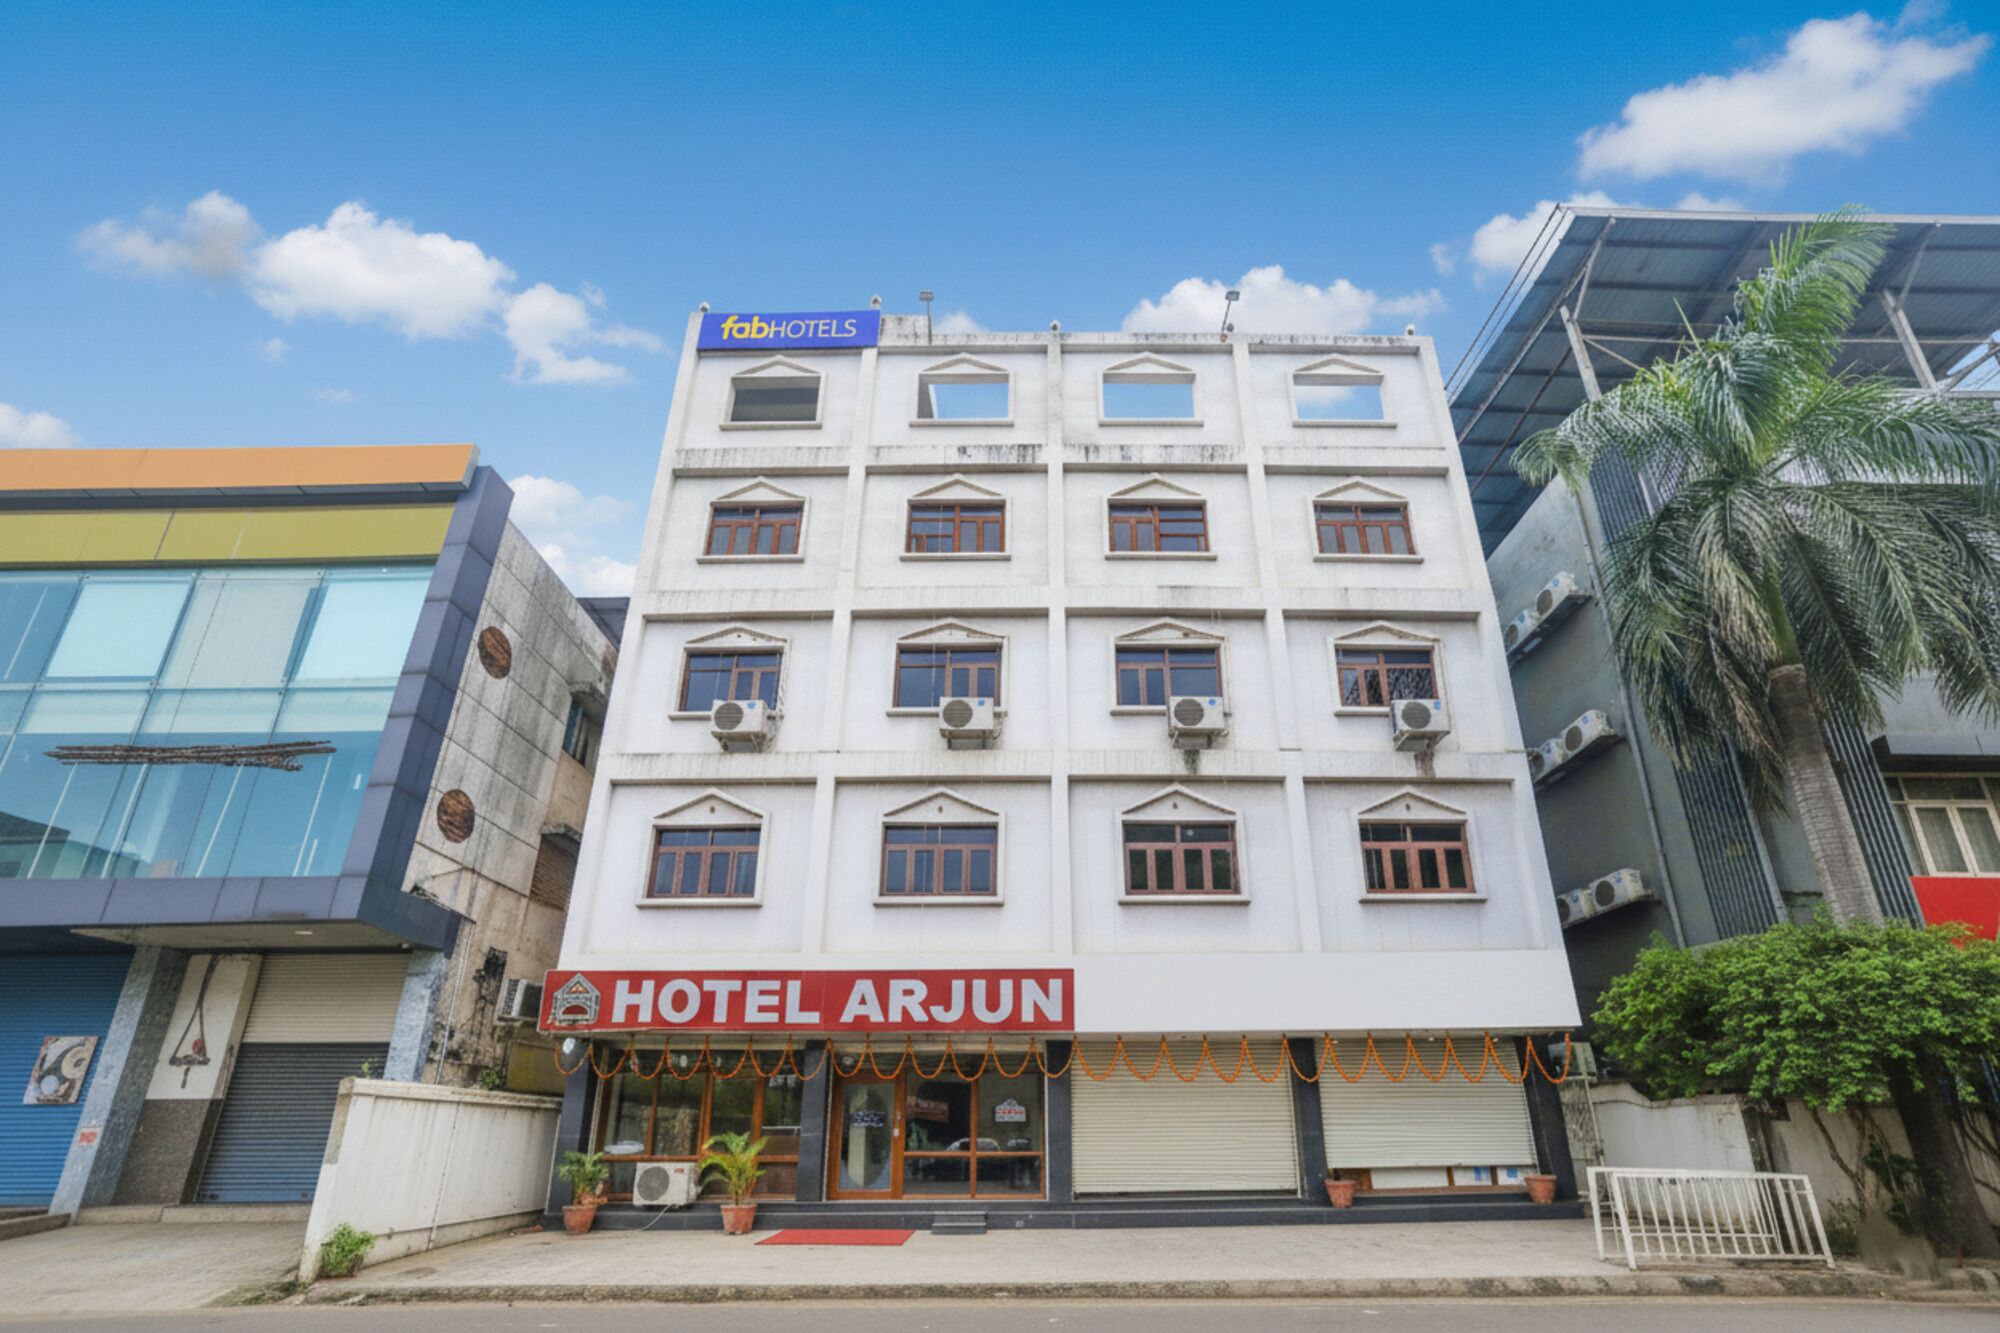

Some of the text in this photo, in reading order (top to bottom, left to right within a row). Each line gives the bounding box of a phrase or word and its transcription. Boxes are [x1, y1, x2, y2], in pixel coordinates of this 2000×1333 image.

[721, 315, 857, 340] fabHOTELS
[611, 978, 1063, 1024] HOTEL ARJUN
